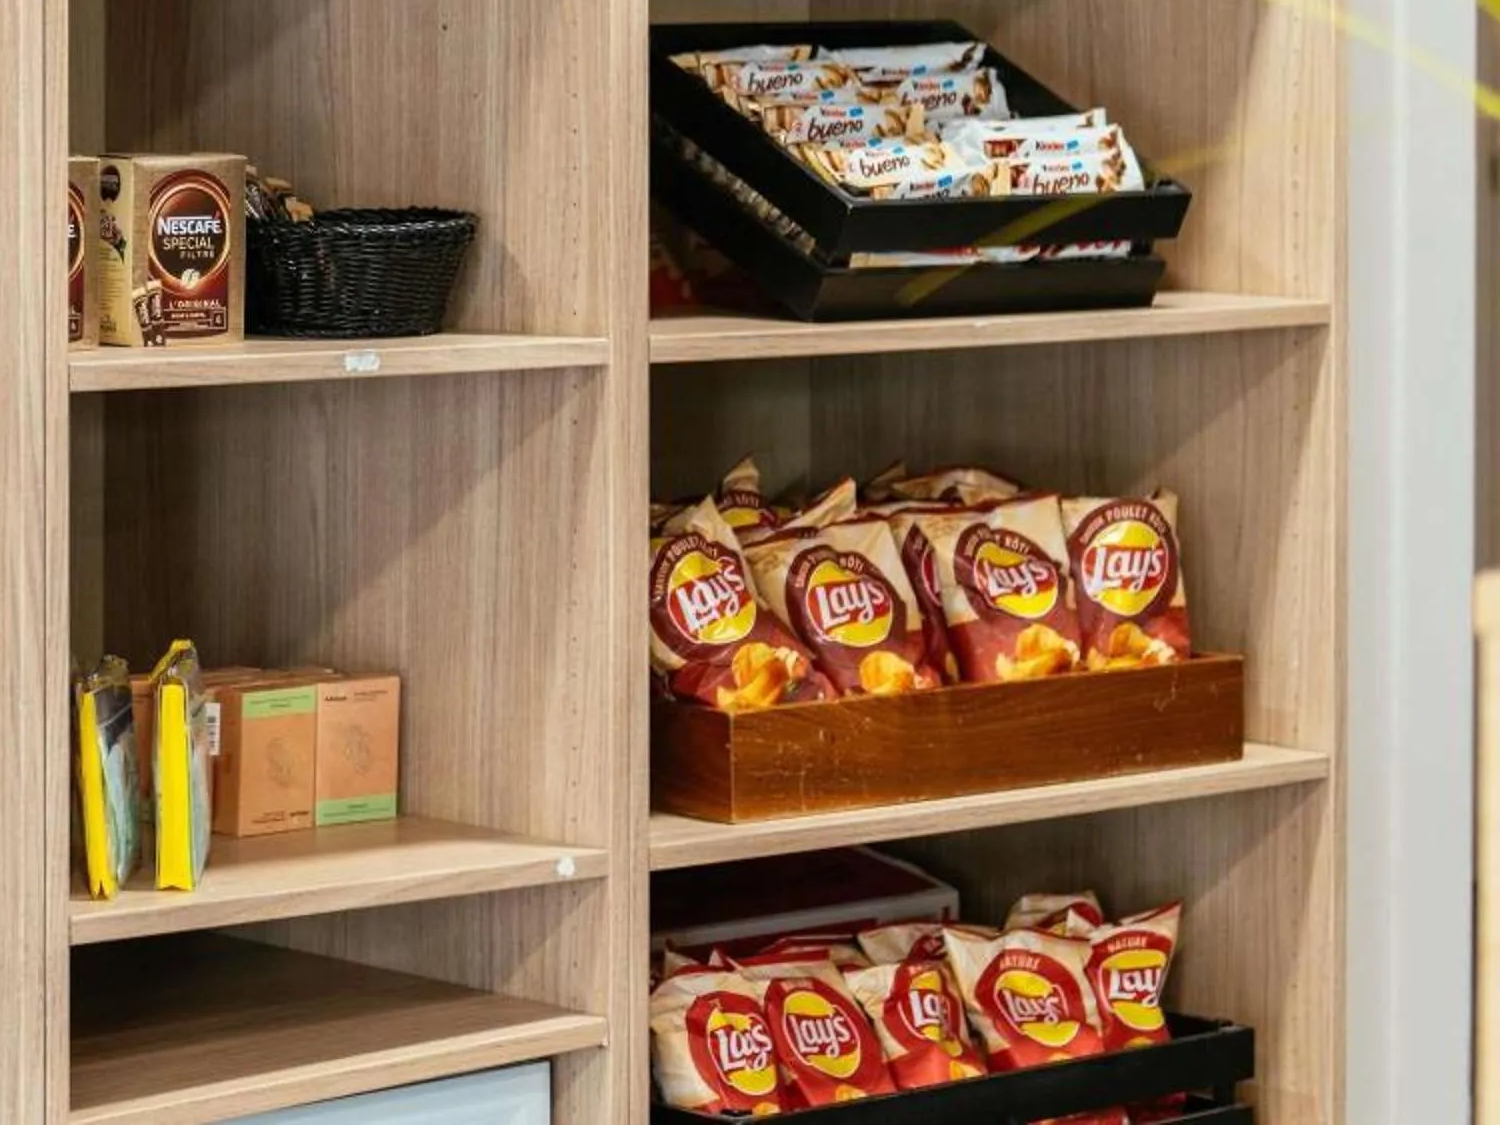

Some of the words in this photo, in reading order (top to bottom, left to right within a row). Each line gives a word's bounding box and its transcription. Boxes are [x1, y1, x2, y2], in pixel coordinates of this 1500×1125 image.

[748, 72, 803, 94] bueno
[807, 117, 864, 141] bueno
[859, 155, 911, 177] bueno
[163, 237, 214, 251] SPECIAL
[1108, 966, 1161, 1008] Lay
